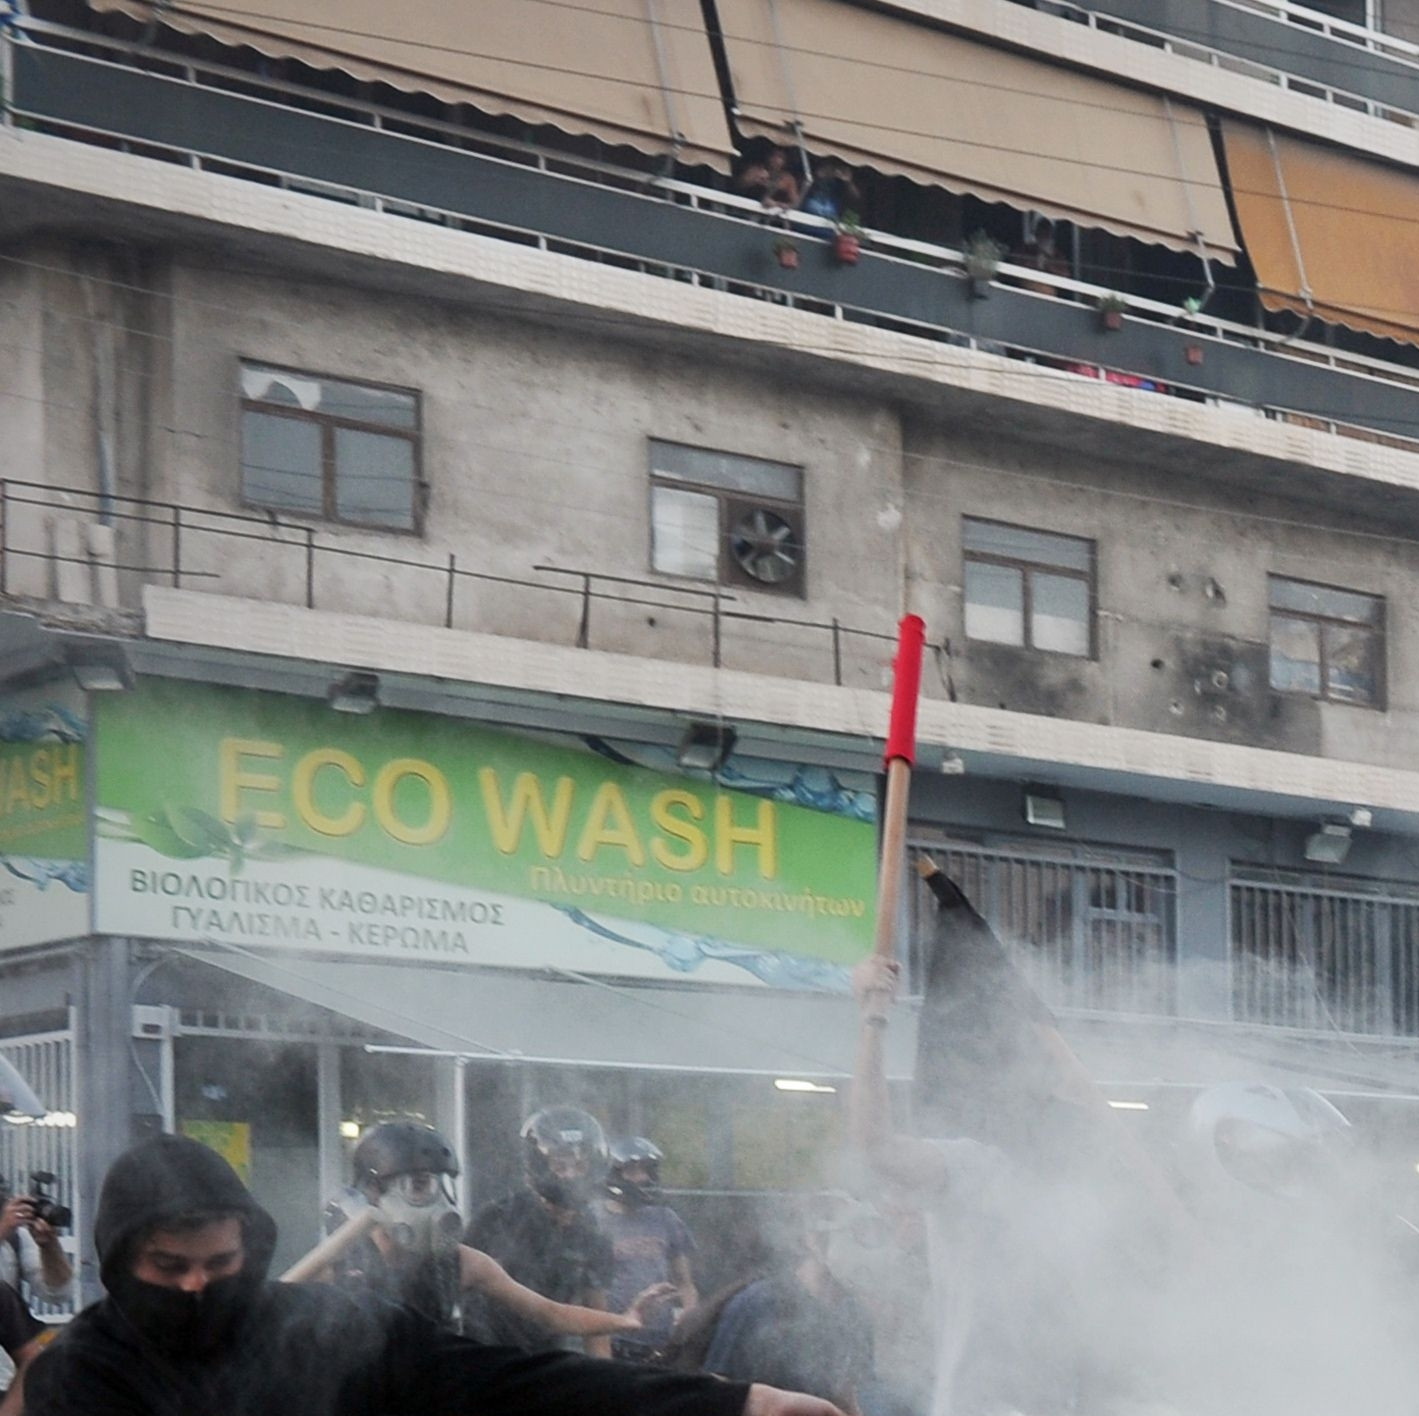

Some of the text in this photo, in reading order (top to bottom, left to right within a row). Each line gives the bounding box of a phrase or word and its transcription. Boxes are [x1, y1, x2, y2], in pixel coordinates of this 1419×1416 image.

[0, 742, 79, 815] ASH
[219, 737, 779, 881] ECO WASH
[130, 868, 505, 926] ΒΙΟΛΟΓΙΚΟΣ ΚΑΘΑΡΙΣΜΟΣ
[530, 864, 865, 920] Πλυντήριο αυτοκινήτων
[171, 905, 322, 943] ΓΥΑΛΙΣΜΑ
[348, 924, 470, 954] ΚΕΡΩΜΑ
